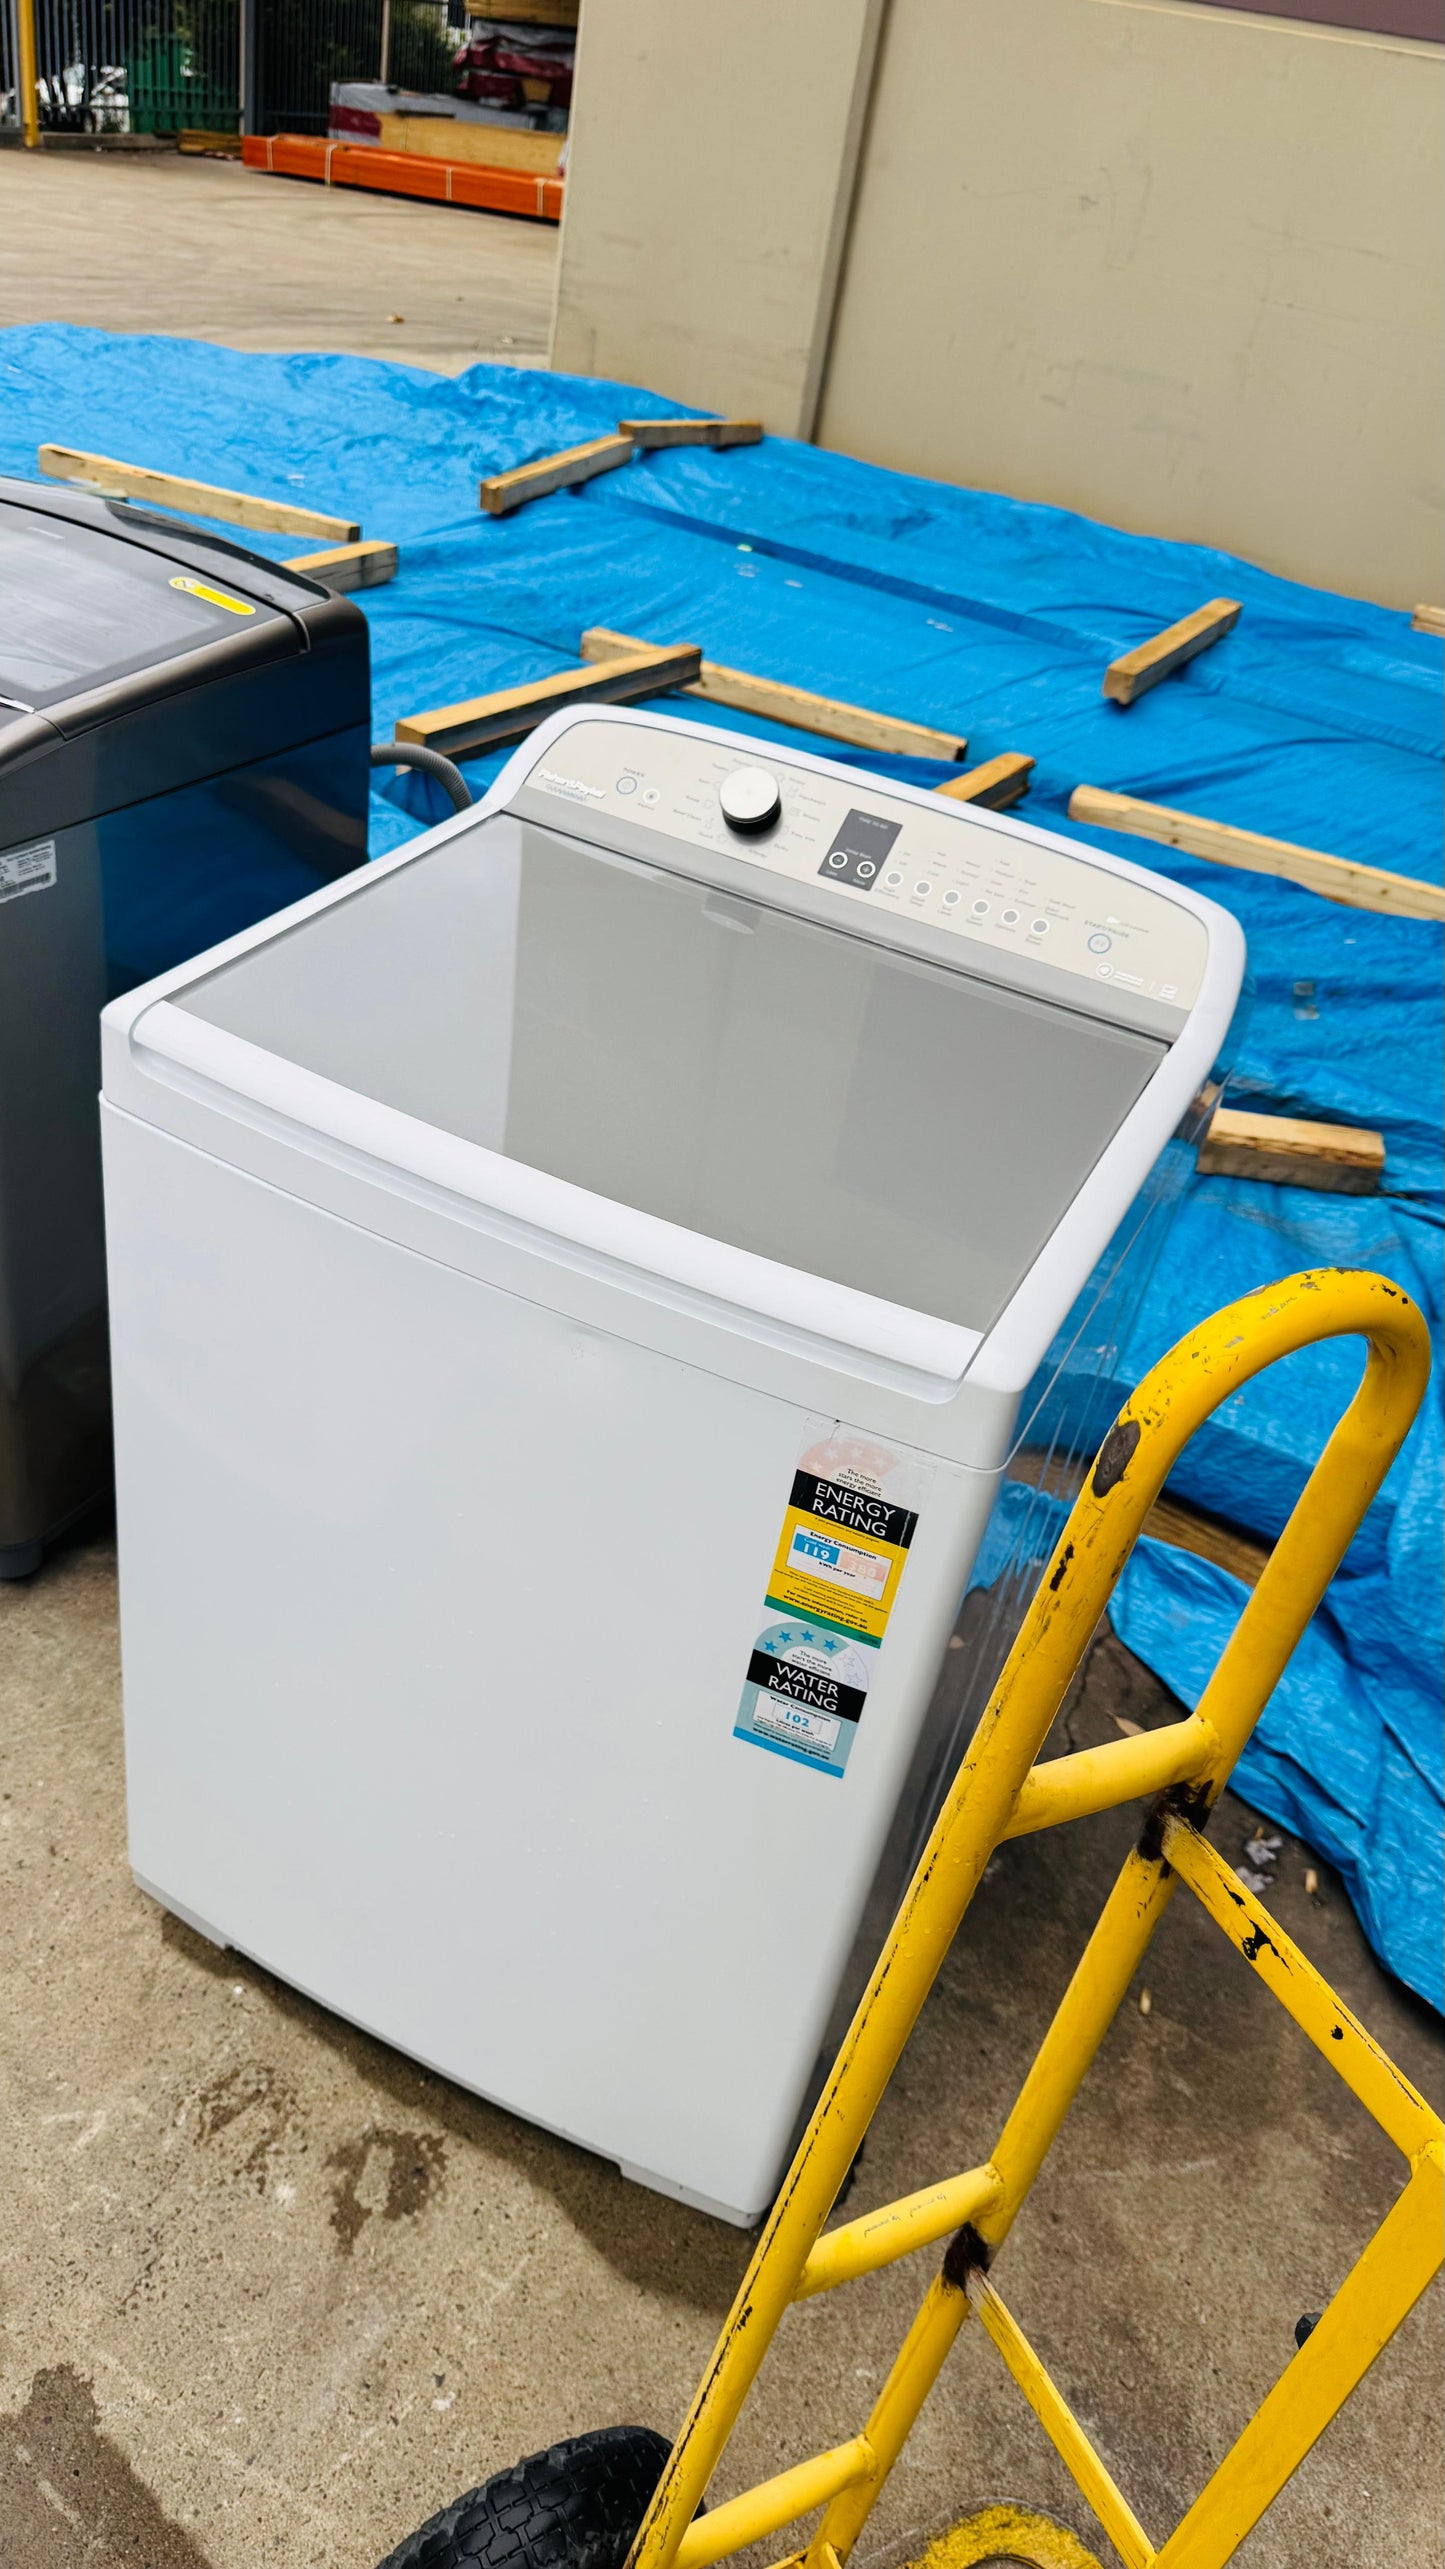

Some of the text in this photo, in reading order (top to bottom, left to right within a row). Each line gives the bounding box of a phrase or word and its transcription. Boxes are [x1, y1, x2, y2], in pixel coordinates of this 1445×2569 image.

[836, 1478, 881, 1497] energy efficient
[860, 1475, 876, 1483] more
[864, 1482, 882, 1492] more
[816, 1482, 895, 1520] ENERGY
[813, 1499, 886, 1536] RATING
[804, 1544, 829, 1559] 119
[810, 1532, 876, 1559] Energy Consumption
[784, 1595, 867, 1629] www.energyrating.gov.au
[768, 1675, 839, 1711] RATING
[777, 1663, 838, 1697] WATER
[770, 1696, 831, 1722] Water Consumption
[786, 1712, 809, 1727] 102
[753, 1728, 830, 1760] www.waterrating.gov.au
